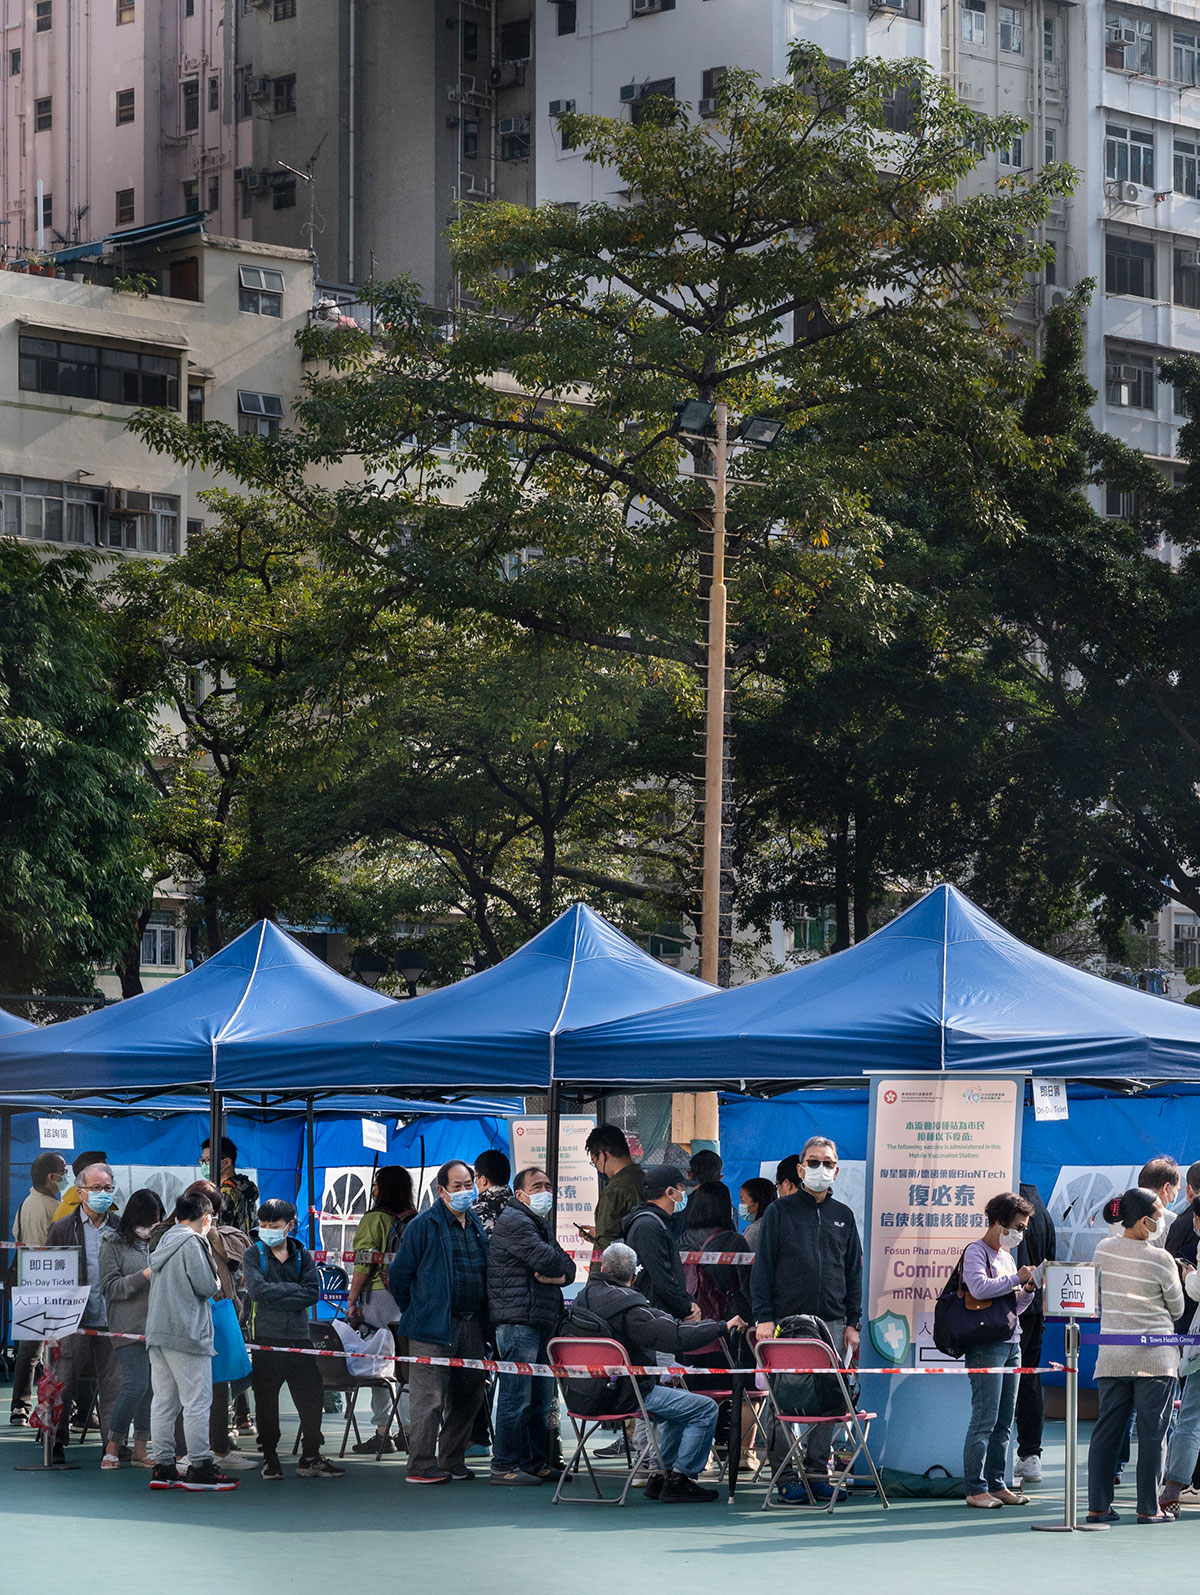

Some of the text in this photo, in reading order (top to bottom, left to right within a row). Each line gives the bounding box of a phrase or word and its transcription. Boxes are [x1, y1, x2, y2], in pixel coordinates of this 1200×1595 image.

[908, 1184, 975, 1206] 復必泰
[884, 1246, 910, 1255] Fosun
[30, 1259, 65, 1271] 即日籌
[894, 1260, 954, 1278] Comirn
[1063, 1274, 1081, 1286] 入口
[893, 1287, 932, 1299] mRNA
[1061, 1288, 1084, 1302] Entry
[14, 1295, 86, 1306] 入口 Entrance
